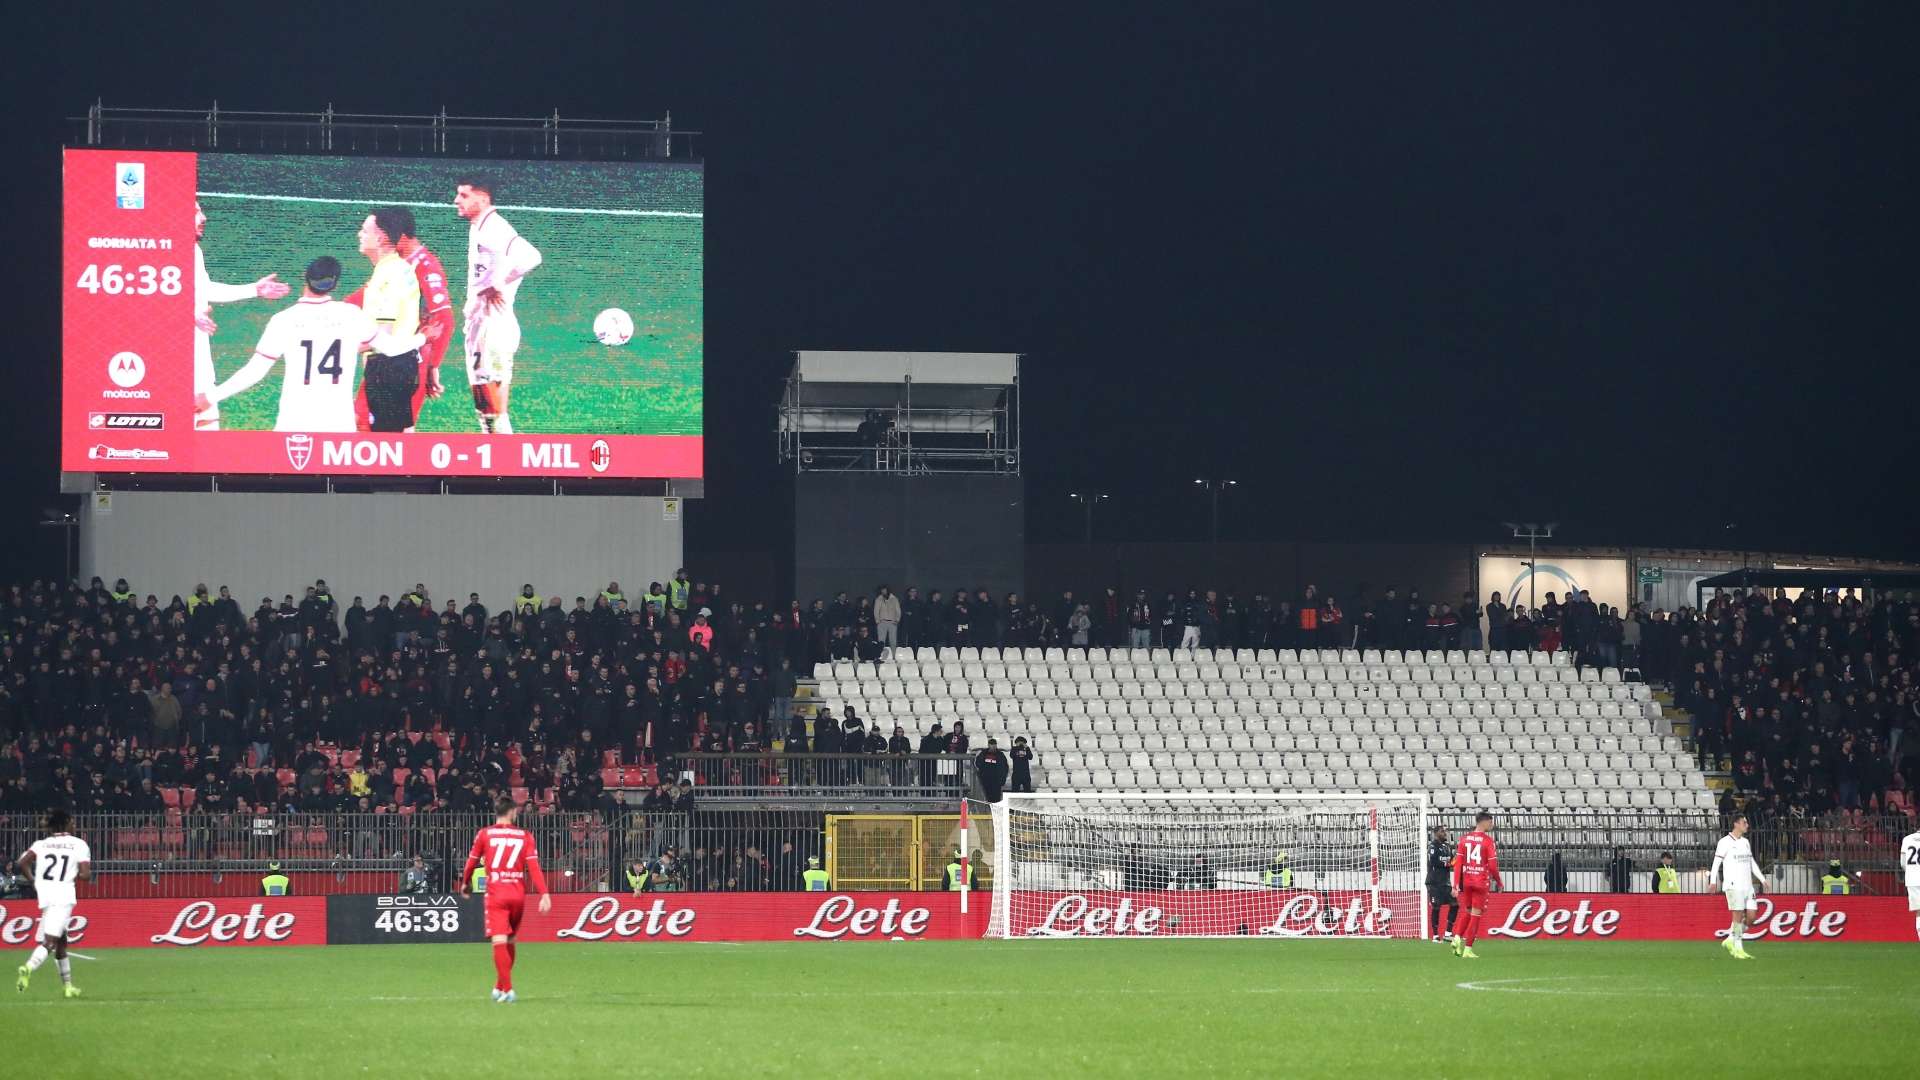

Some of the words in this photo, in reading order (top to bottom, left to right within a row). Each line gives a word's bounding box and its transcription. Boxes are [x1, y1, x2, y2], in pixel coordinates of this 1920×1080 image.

[88, 237, 157, 249] GIORNATA
[159, 238, 172, 250] 11
[76, 264, 182, 296] 46:38
[300, 338, 343, 386] 14
[103, 389, 151, 399] motorola
[107, 416, 162, 426] LOTTO
[322, 440, 404, 467] MON
[521, 442, 580, 468] MIL
[42, 853, 70, 882] 21
[489, 837, 524, 869] 77
[1464, 842, 1482, 865] 14
[377, 896, 457, 906] BOLVA
[793, 895, 930, 939] Lete
[1028, 894, 1163, 937] Lete
[1258, 894, 1393, 936] Lete
[1487, 895, 1621, 939] Lete
[150, 900, 296, 945] Lete
[374, 909, 460, 933] 46:38
[556, 896, 696, 940] Lete
